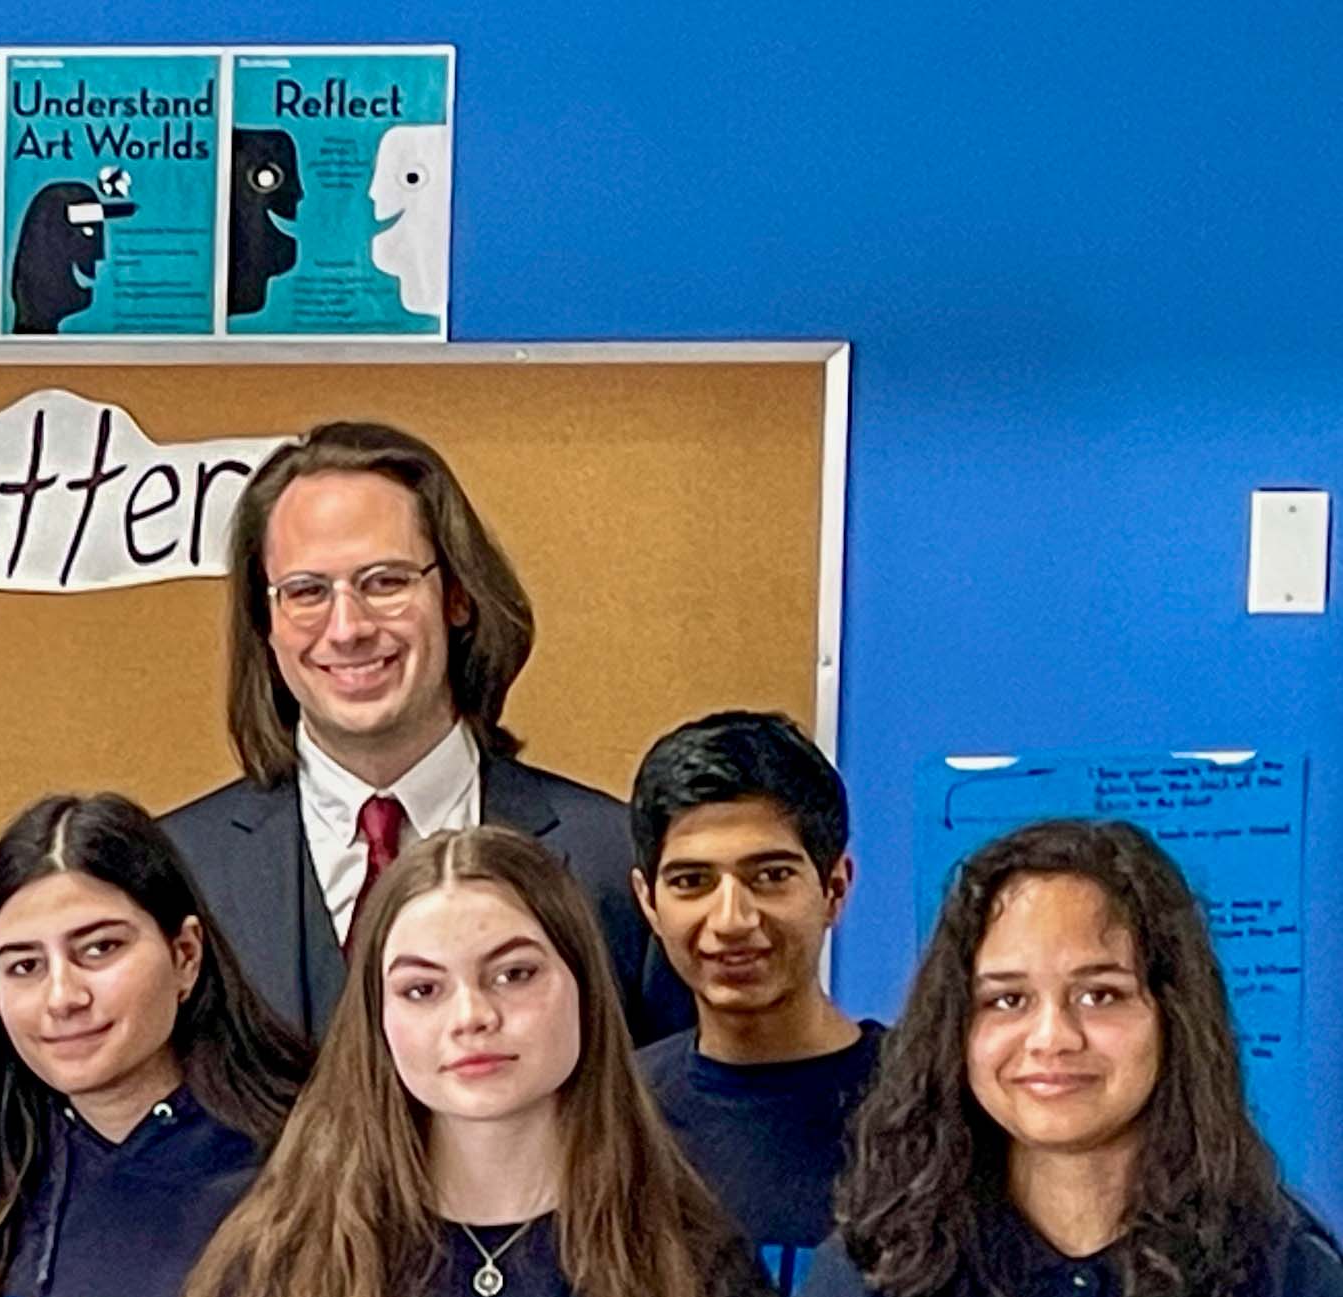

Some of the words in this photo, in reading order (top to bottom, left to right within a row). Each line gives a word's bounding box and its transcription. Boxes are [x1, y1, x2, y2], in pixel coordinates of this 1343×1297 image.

[14, 78, 215, 118] Understand
[275, 77, 404, 118] Reflect
[13, 123, 73, 160] Art
[85, 121, 210, 160] Worlds
